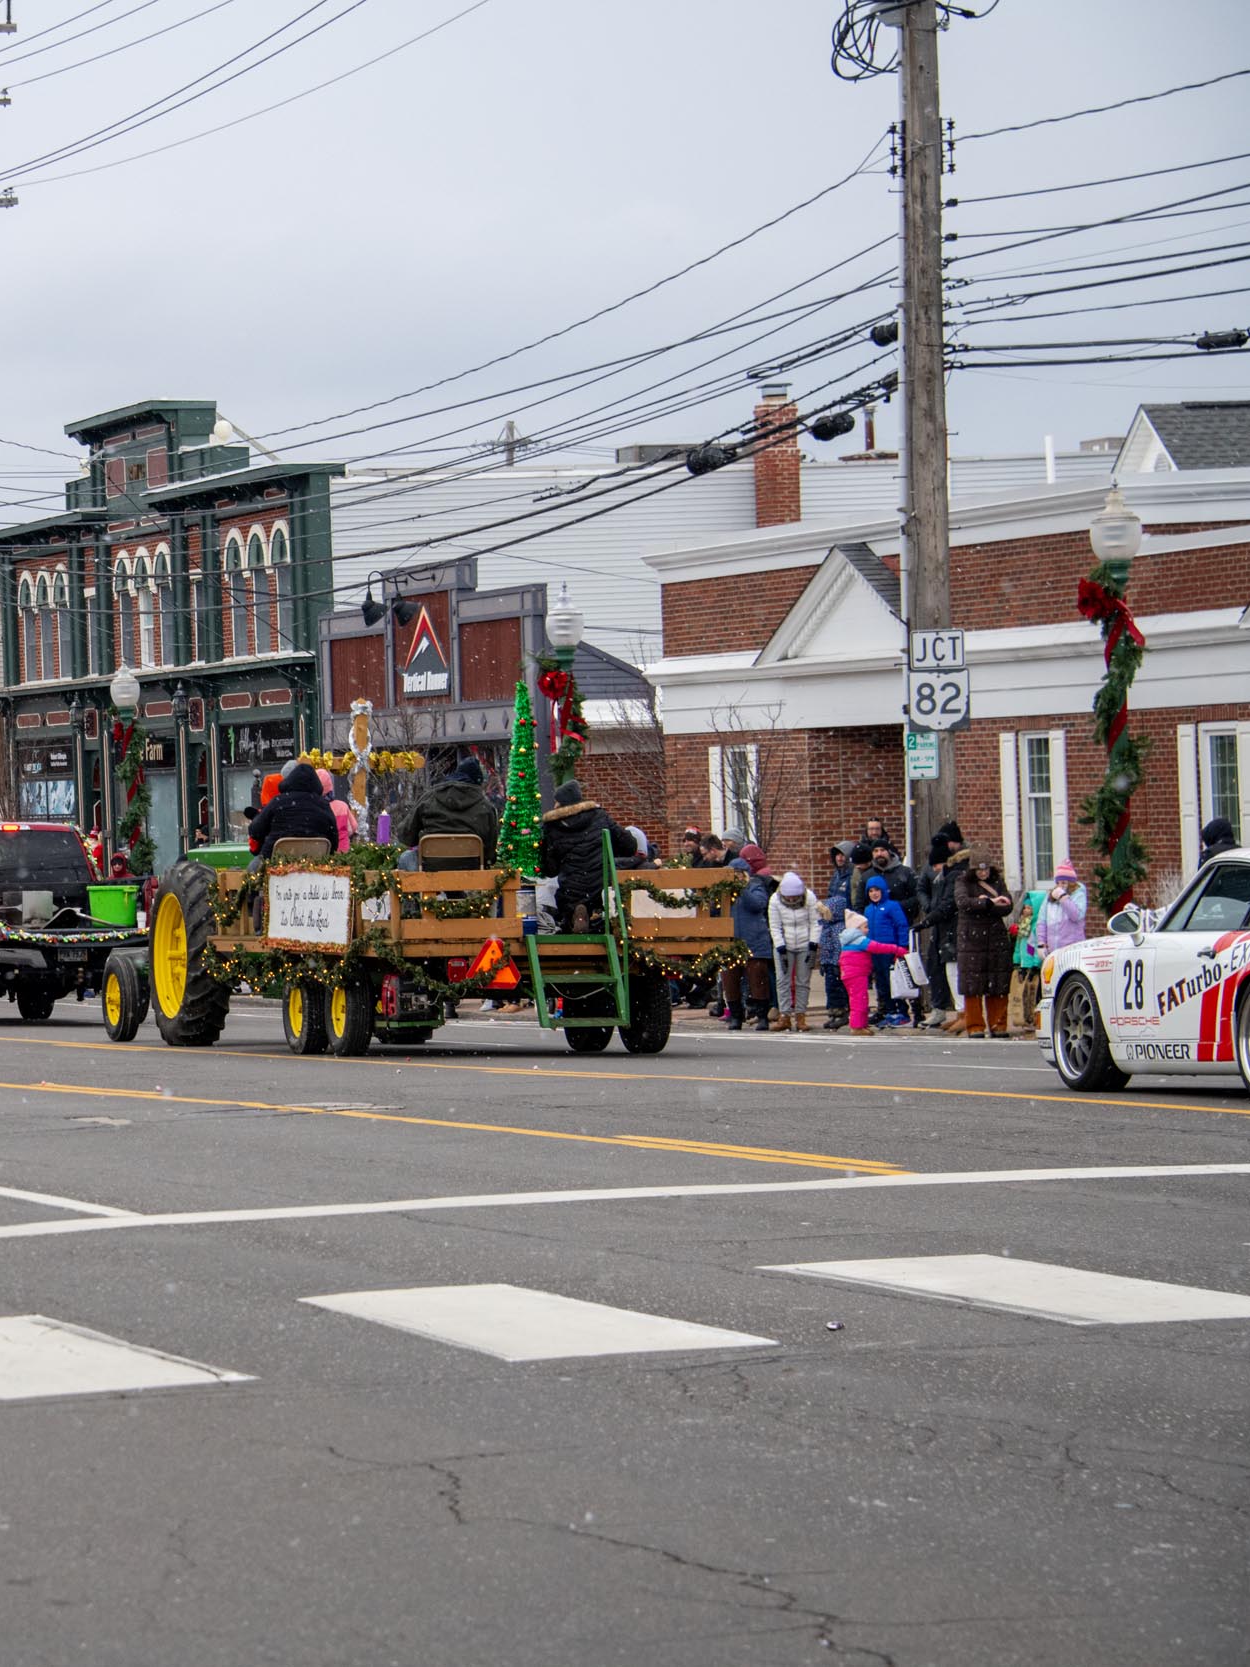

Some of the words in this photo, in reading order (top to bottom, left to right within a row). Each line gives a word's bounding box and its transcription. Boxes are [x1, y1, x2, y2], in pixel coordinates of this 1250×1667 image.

[916, 636, 960, 662] JCT
[402, 671, 427, 693] Vertical
[916, 682, 962, 716] 82
[145, 737, 163, 761] Farm
[908, 735, 915, 749] 2
[1123, 959, 1144, 1010] 28
[1110, 1016, 1160, 1026] PORSCHE
[1135, 1043, 1190, 1060] PIONEER
